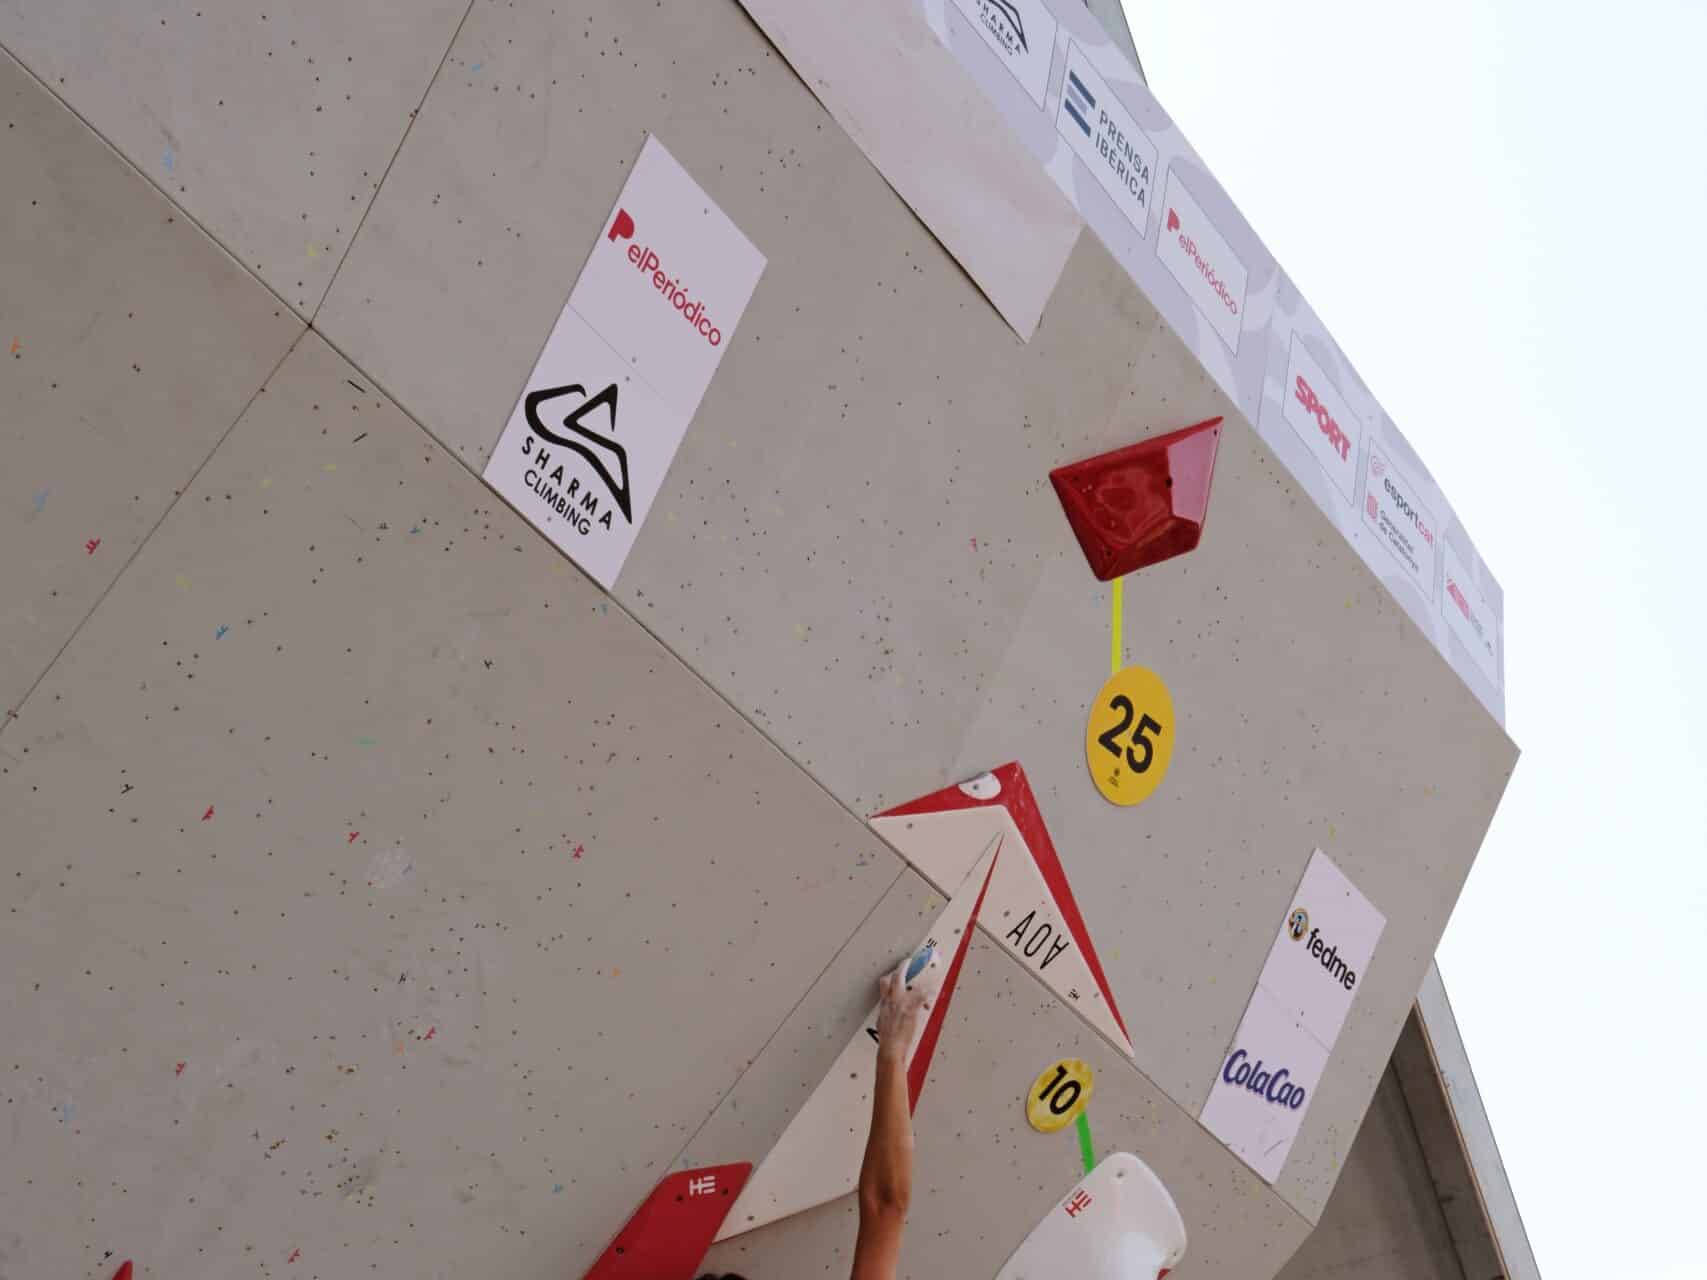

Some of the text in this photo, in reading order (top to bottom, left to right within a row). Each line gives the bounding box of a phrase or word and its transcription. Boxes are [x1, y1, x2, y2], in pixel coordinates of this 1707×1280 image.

[980, 14, 1013, 56] CLIMBING
[1095, 131, 1146, 208] IBÉRICA
[1099, 109, 1150, 185] PRENSA
[627, 243, 722, 346] elPeriódico
[1178, 233, 1238, 316] elPeriódico
[1295, 375, 1351, 462] SPORT
[521, 436, 613, 531] SHARMA
[523, 469, 591, 536] CLIMBING
[1384, 477, 1433, 545] esportcat
[1098, 693, 1162, 774] 25
[1306, 927, 1357, 990] fedme
[1038, 1064, 1082, 1116] 10
[1222, 1049, 1305, 1110] ColaCao
